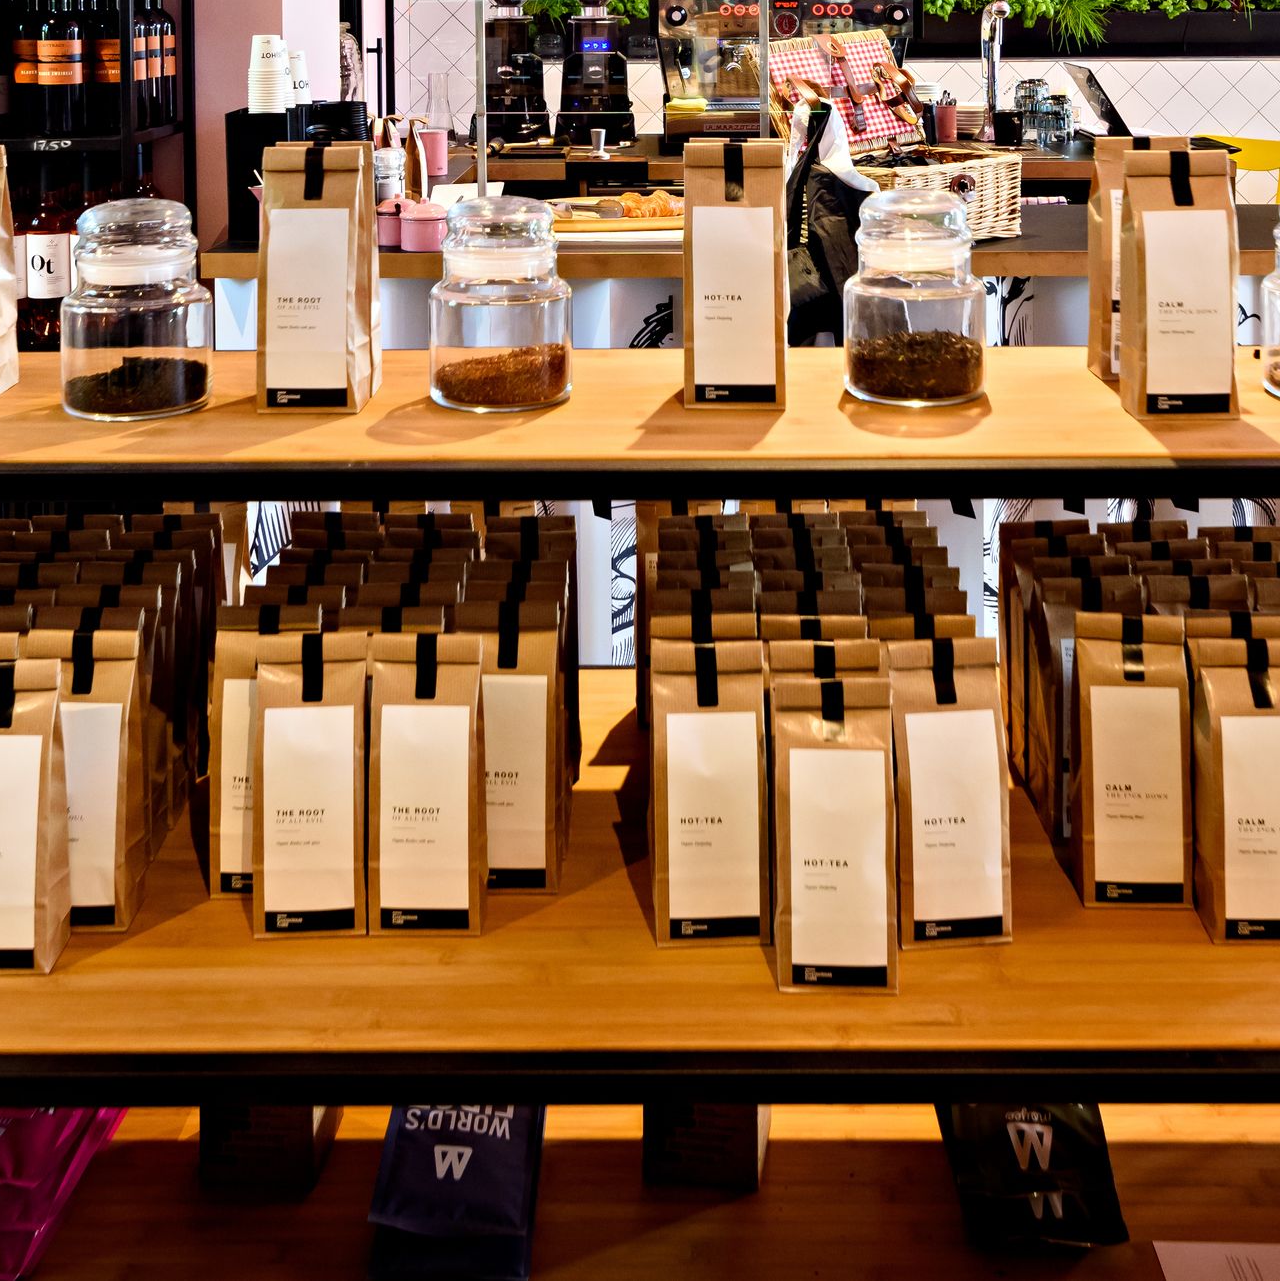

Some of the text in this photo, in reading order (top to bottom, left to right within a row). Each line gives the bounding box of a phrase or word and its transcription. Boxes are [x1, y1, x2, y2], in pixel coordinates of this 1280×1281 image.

[276, 809, 326, 817] THE ROOT
[393, 806, 440, 814] THE ROOT
[405, 1108, 511, 1140] WORLD'S
